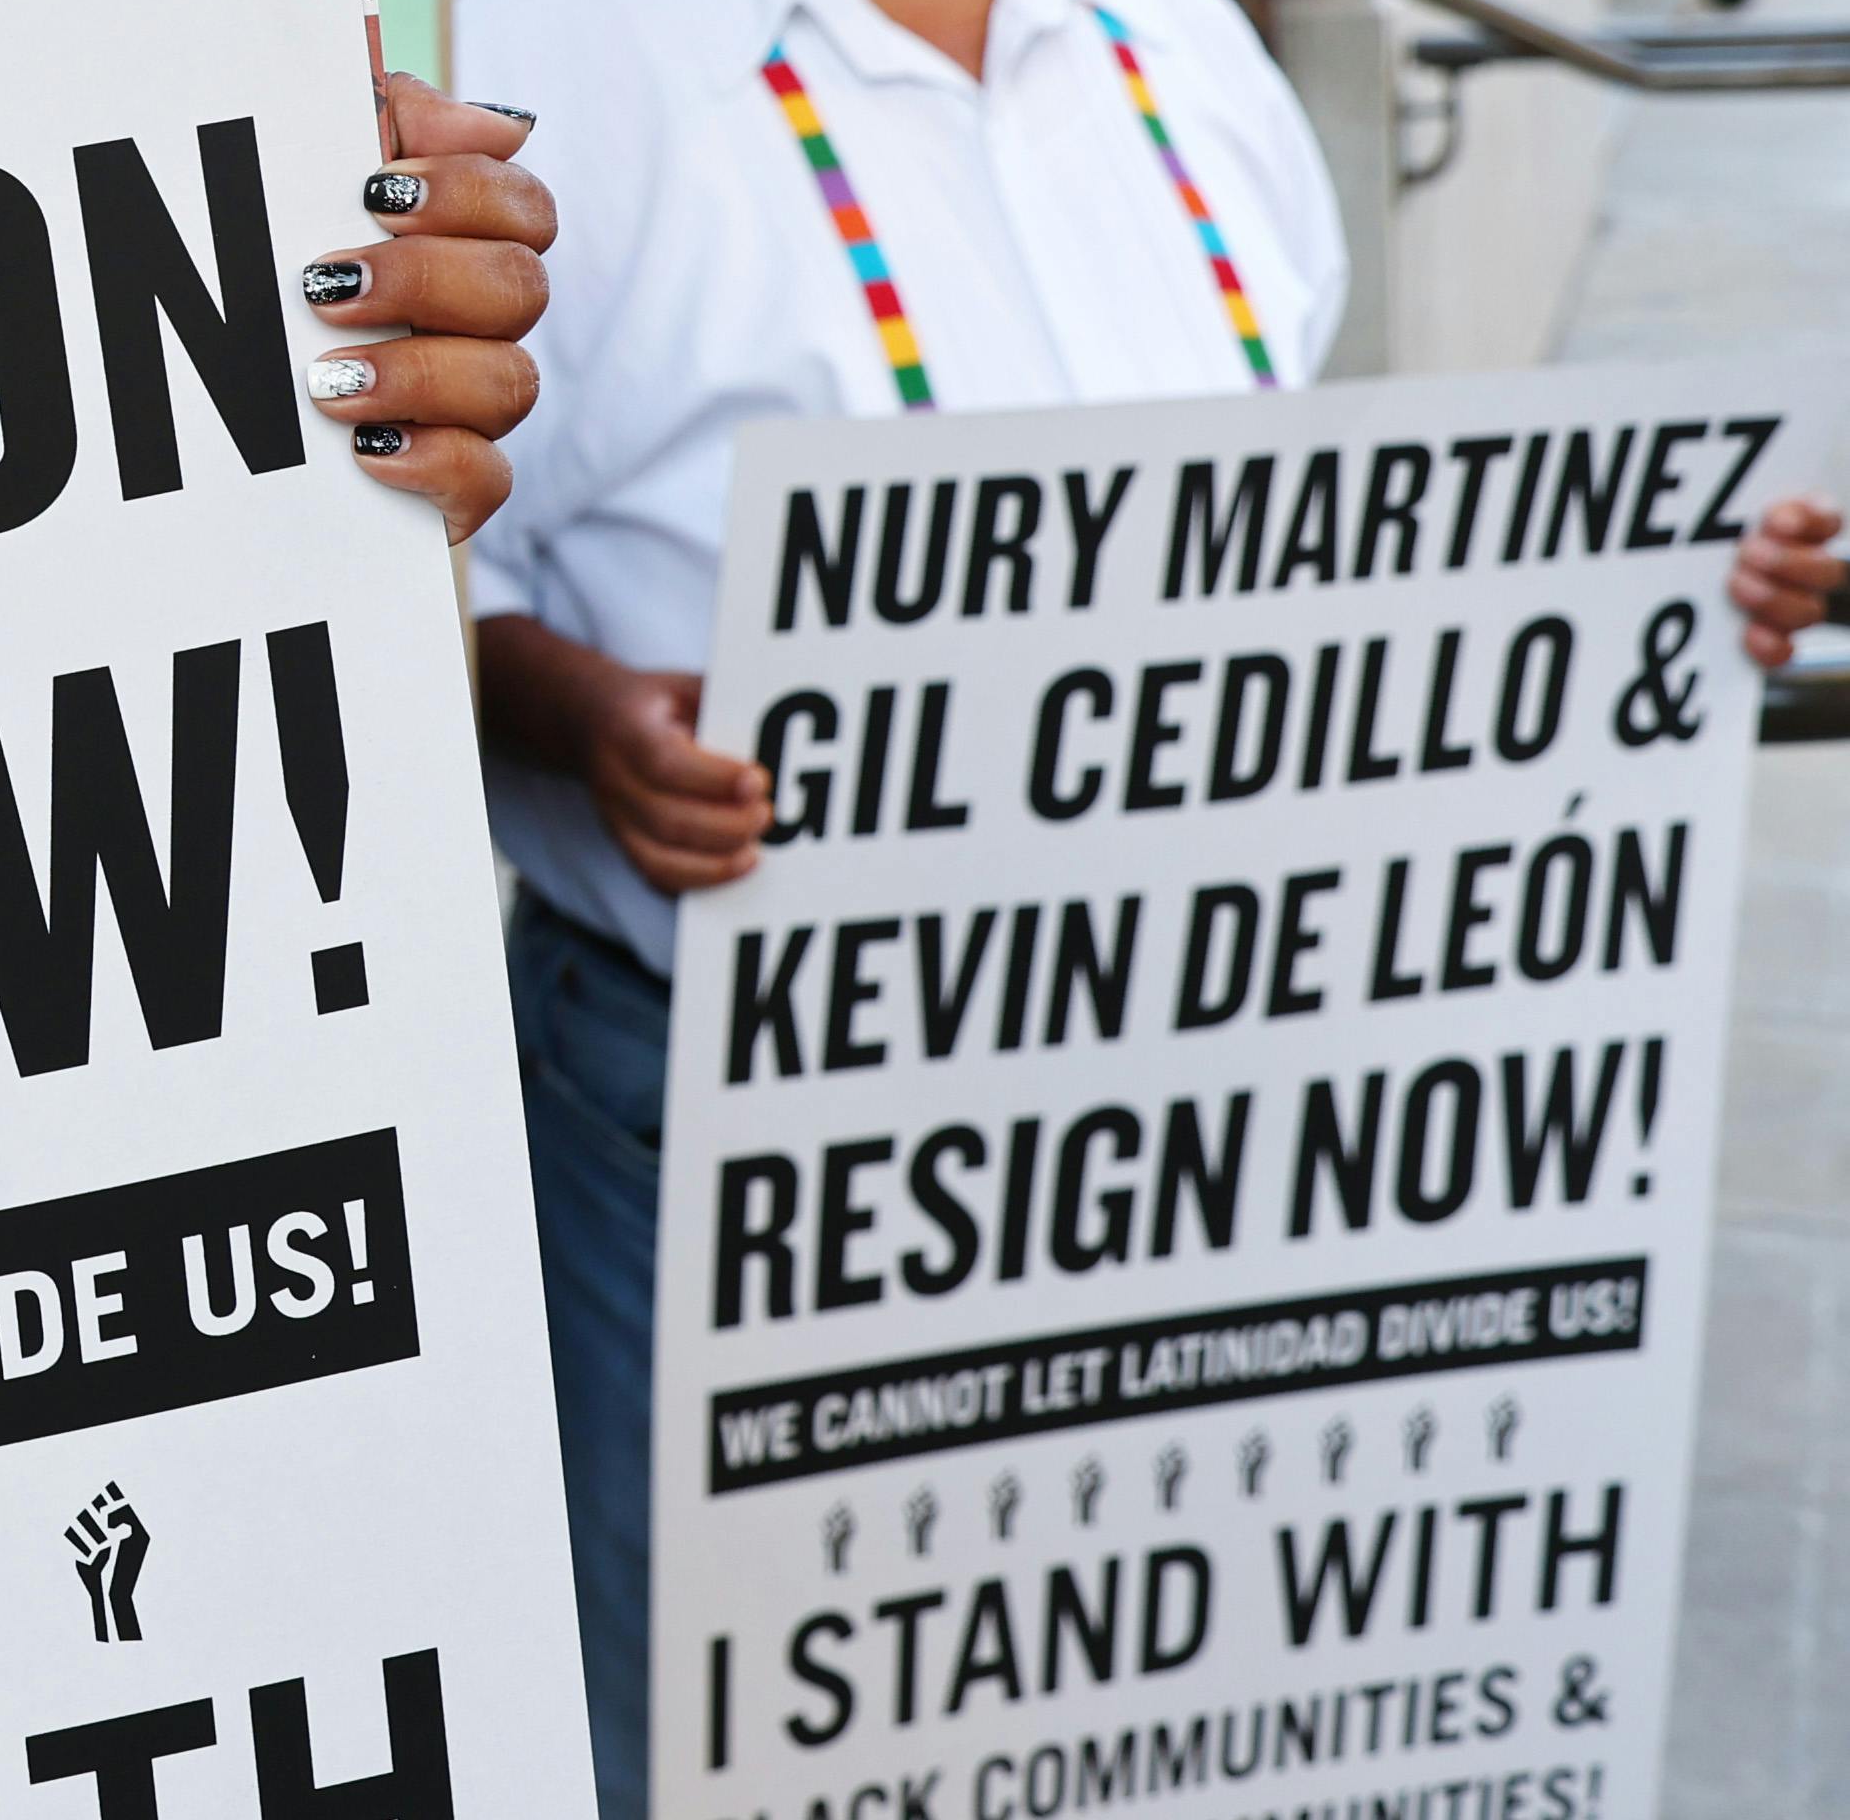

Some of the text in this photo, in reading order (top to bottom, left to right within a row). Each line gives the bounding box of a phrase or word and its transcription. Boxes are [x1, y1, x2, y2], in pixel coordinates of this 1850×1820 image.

[773, 417, 1782, 633] NURY MARTINEZ
[755, 599, 1702, 848] GIL CEDILLO &
[725, 792, 1688, 1086] KEVIN DE LEÓN
[181, 1198, 376, 1337] US!
[712, 1037, 1664, 1331] RESIGN NOW!
[718, 1275, 1640, 1469] WE CANNOT LET LATINIDAD DIVIDE US!
[705, 1484, 1624, 1773] I STAND WITH
[975, 1665, 1518, 1820] COMMUNITIES
[1553, 1654, 1611, 1727] &
